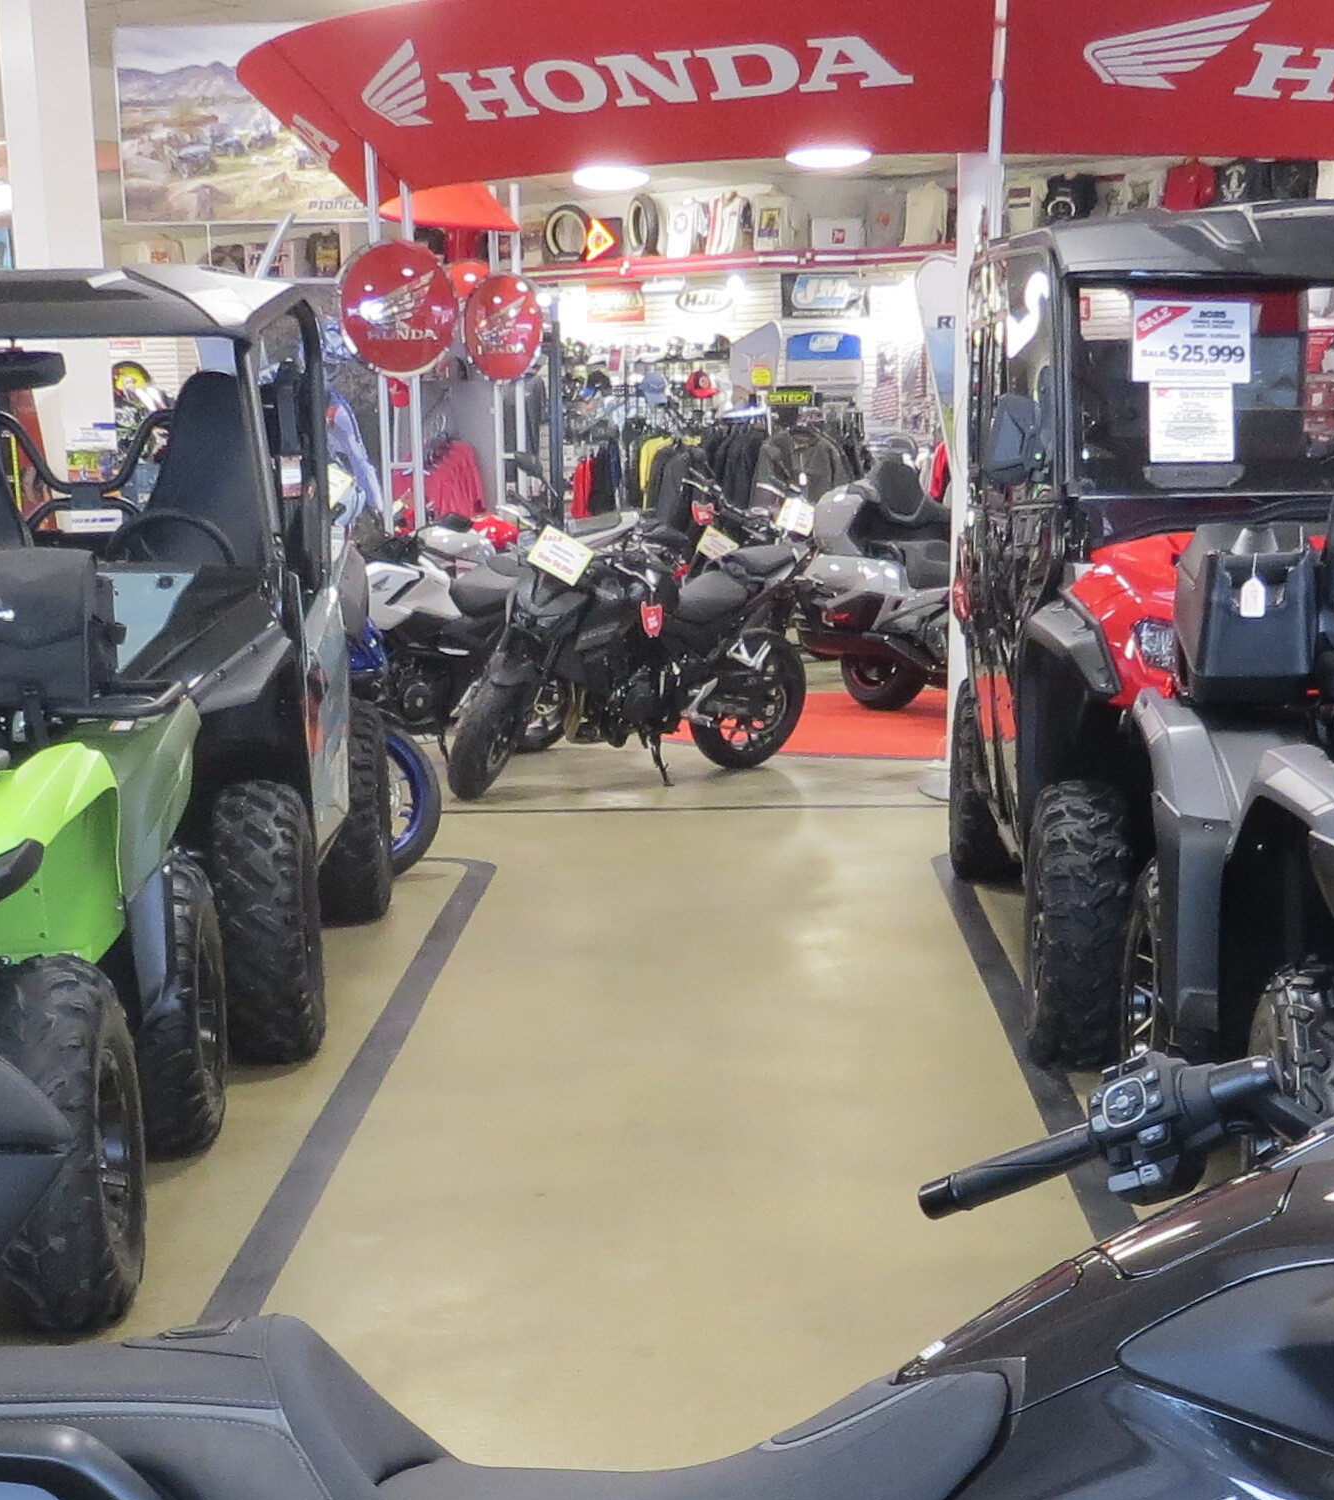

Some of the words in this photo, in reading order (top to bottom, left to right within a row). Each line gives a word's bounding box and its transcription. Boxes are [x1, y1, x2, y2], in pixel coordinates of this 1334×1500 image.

[437, 35, 914, 121] HONDA
[1137, 306, 1172, 332] SALE
[1168, 343, 1245, 365] $25,999
